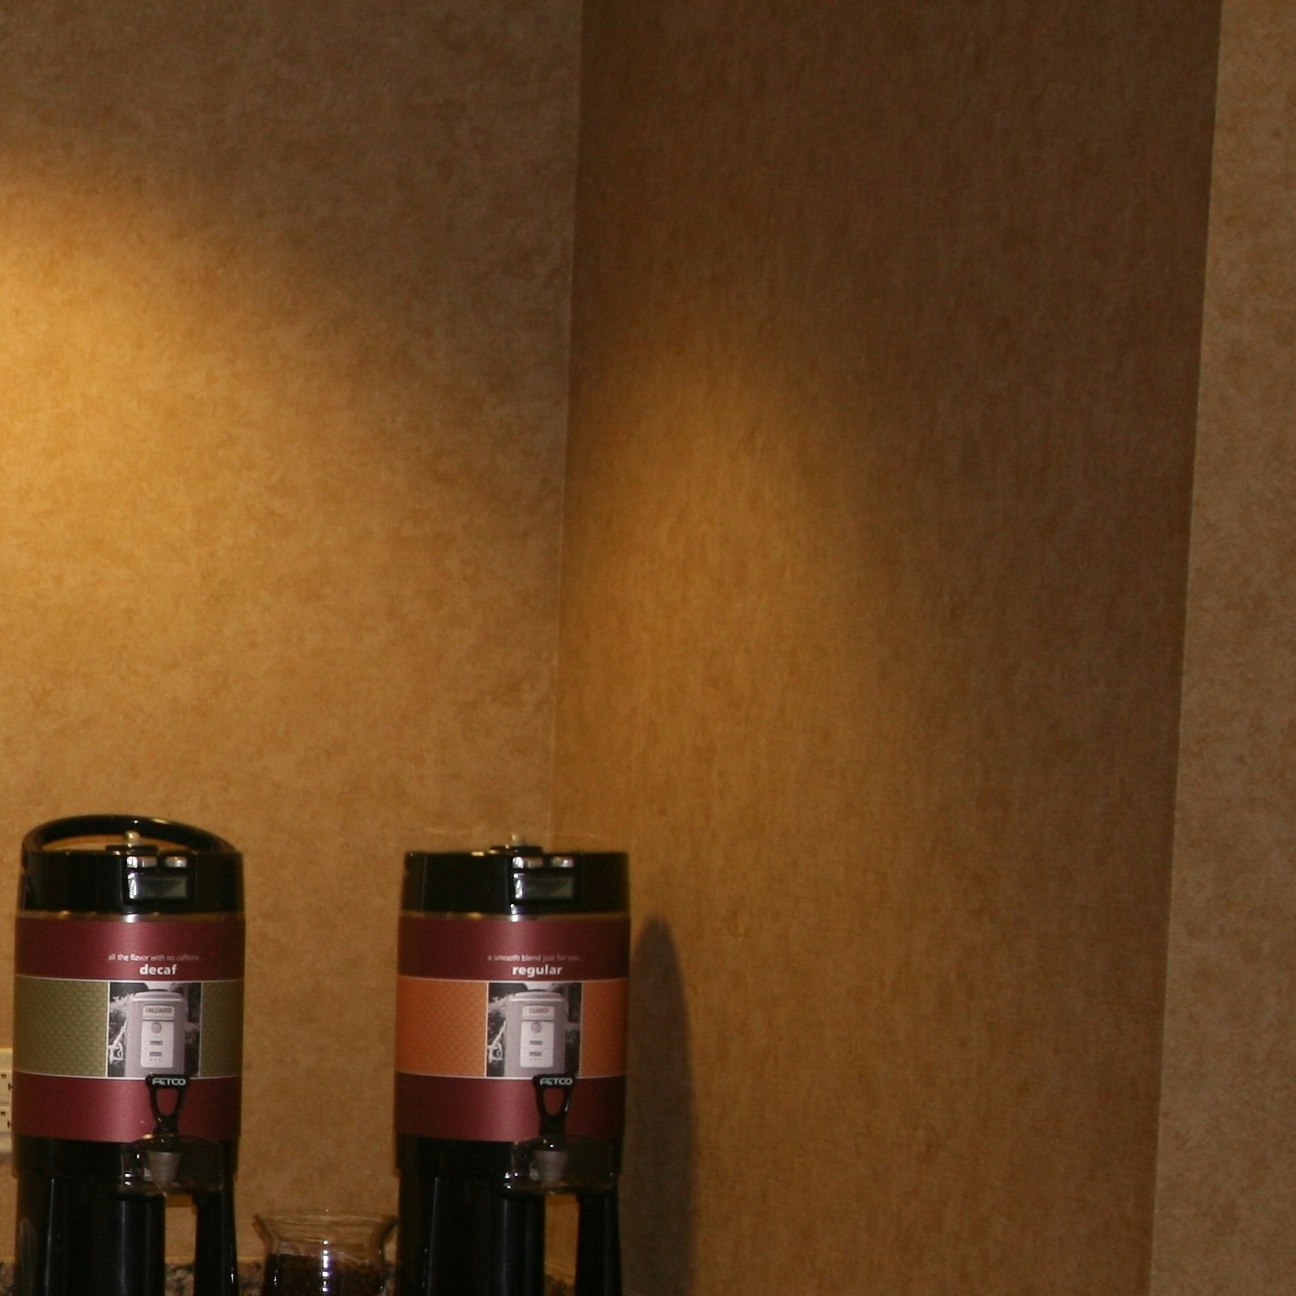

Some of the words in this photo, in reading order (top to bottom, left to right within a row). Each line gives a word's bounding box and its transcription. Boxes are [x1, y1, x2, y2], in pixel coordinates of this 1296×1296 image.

[139, 963, 178, 976] decaf
[511, 964, 564, 978] regular
[152, 1077, 186, 1086] FETCO
[539, 1077, 573, 1086] FETCO
